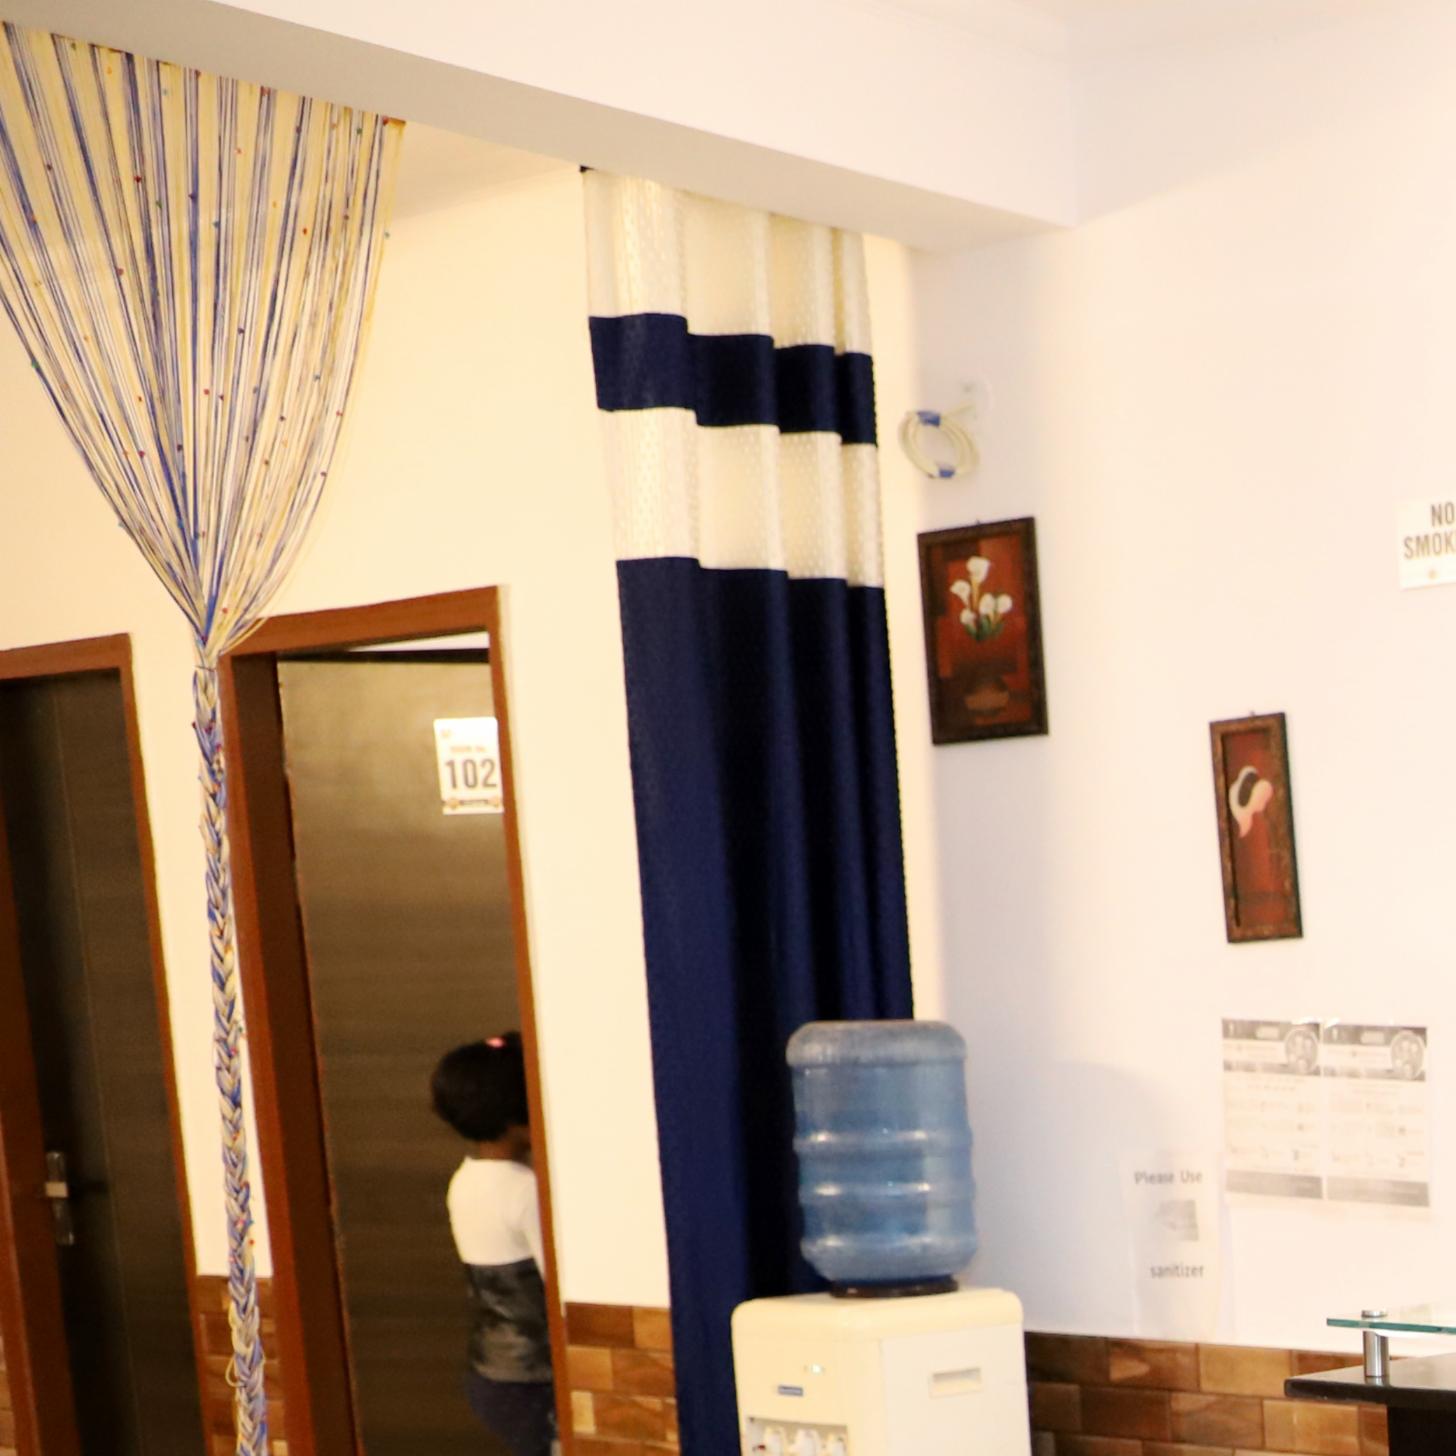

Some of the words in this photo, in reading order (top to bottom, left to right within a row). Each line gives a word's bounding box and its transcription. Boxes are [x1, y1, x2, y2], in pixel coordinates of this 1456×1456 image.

[1430, 501, 1455, 527] NO
[444, 758, 497, 789] 102
[1134, 1171, 1174, 1185] Please
[1180, 1170, 1203, 1184] Use
[1150, 1262, 1204, 1279] sanitizer
